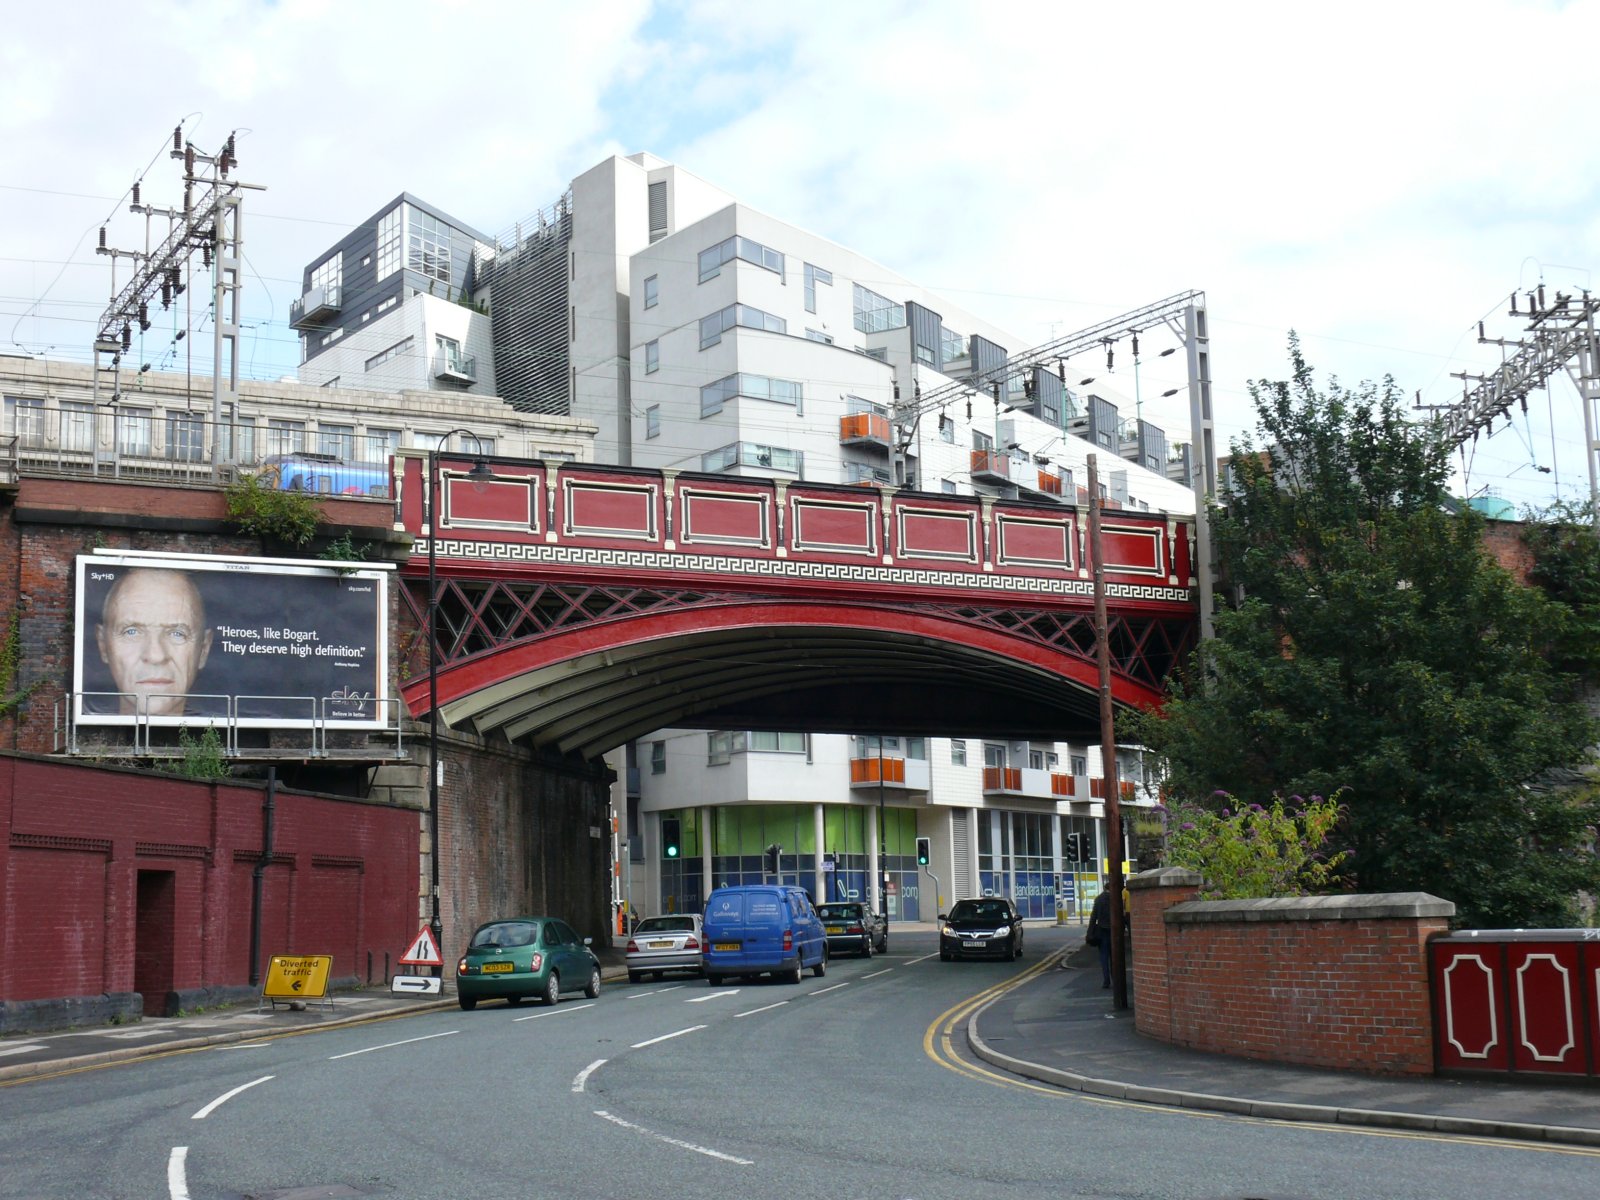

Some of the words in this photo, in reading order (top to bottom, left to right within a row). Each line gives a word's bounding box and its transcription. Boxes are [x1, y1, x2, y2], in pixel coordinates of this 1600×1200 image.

[90, 572, 115, 580] Sky+HD
[216, 625, 261, 640] “Heroes,
[263, 627, 281, 639] like
[283, 628, 320, 643] Bogart.
[221, 640, 247, 656] They
[248, 641, 288, 655] deserve
[290, 643, 312, 658] high
[315, 644, 366, 658] definition.”
[331, 685, 370, 711] sky
[1014, 882, 1055, 897] dandara.com
[280, 959, 319, 968] Diverted
